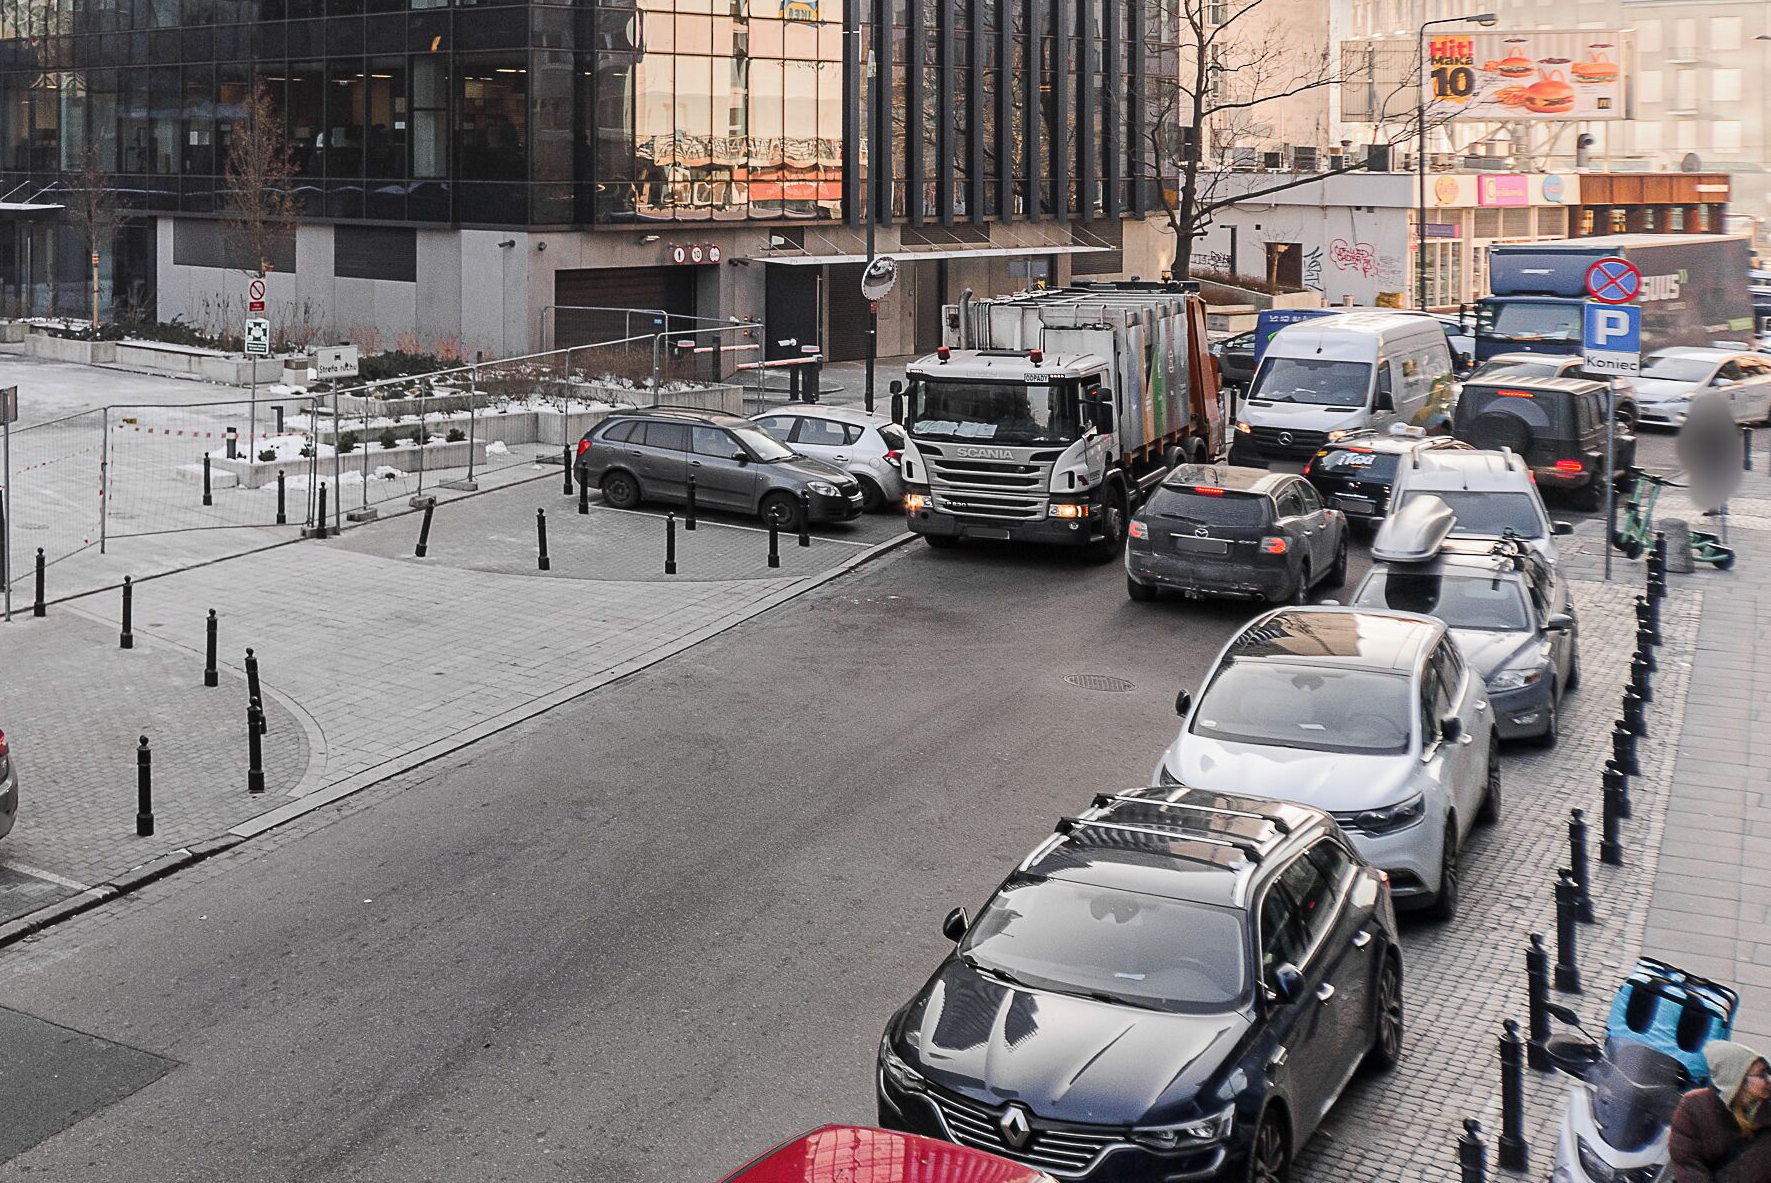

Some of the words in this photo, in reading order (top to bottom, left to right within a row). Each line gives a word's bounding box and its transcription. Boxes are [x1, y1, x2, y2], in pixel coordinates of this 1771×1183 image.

[1430, 39, 1474, 57] Hit!
[1430, 66, 1476, 97] 10
[1595, 309, 1630, 345] P
[319, 364, 338, 374] Strefa
[1586, 356, 1638, 371] Koniec
[957, 447, 1014, 459] SCANIA
[1337, 452, 1377, 466] iTaxi
